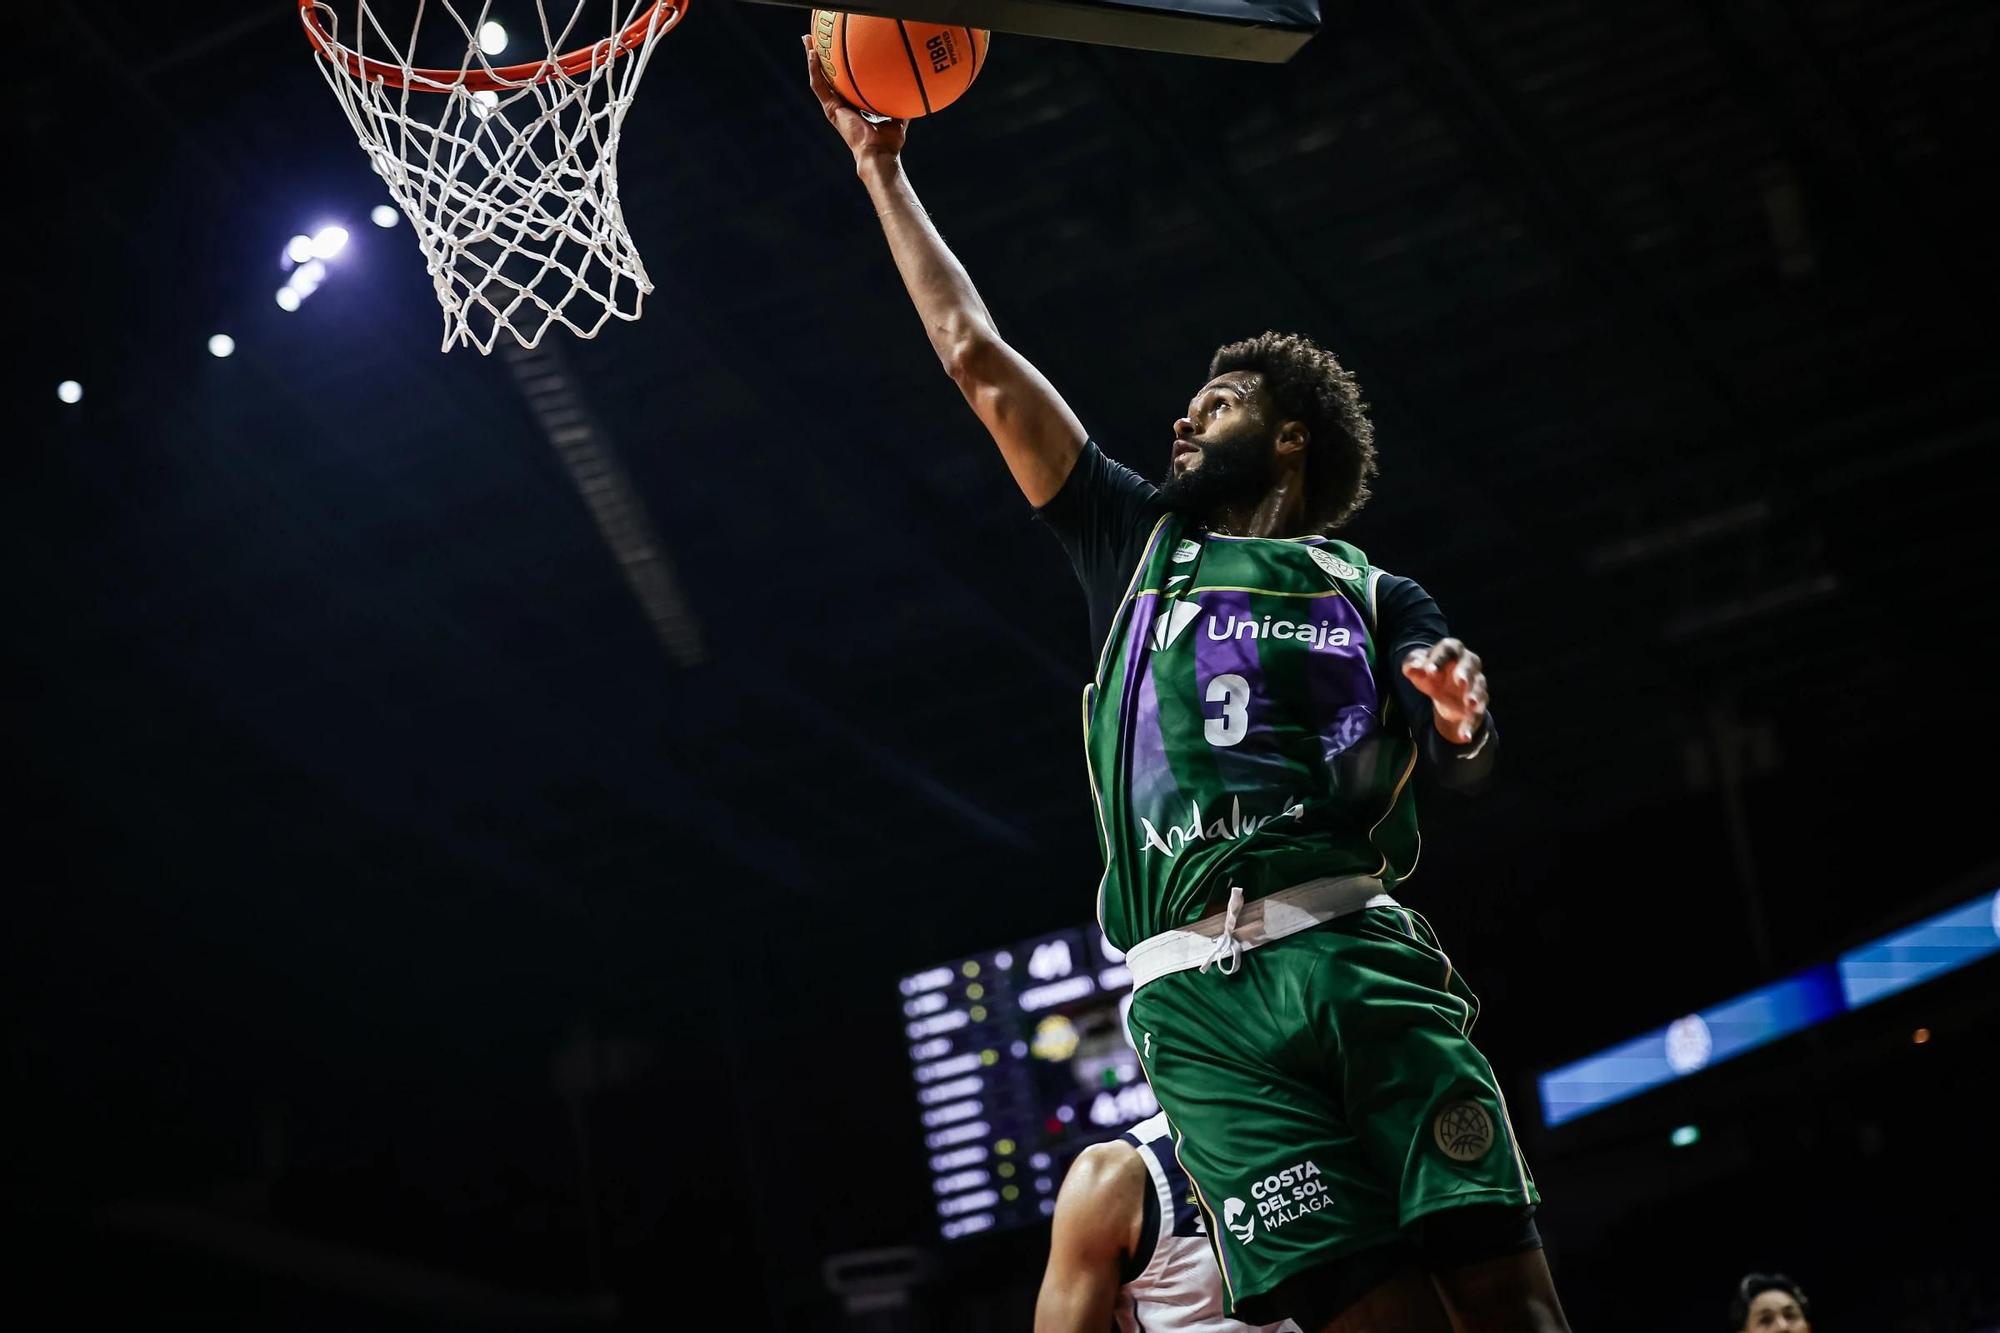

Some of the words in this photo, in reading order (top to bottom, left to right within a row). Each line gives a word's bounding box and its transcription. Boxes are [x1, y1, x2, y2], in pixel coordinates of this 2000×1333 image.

[926, 35, 950, 74] FIBA
[1207, 614, 1351, 650] Unicaja
[1203, 673, 1251, 747] 3
[1251, 1160, 1321, 1200] COSTA
[1256, 1193, 1292, 1218] DEL
[1292, 1179, 1328, 1201] SOL
[1263, 1194, 1334, 1232] MÁLAGA
